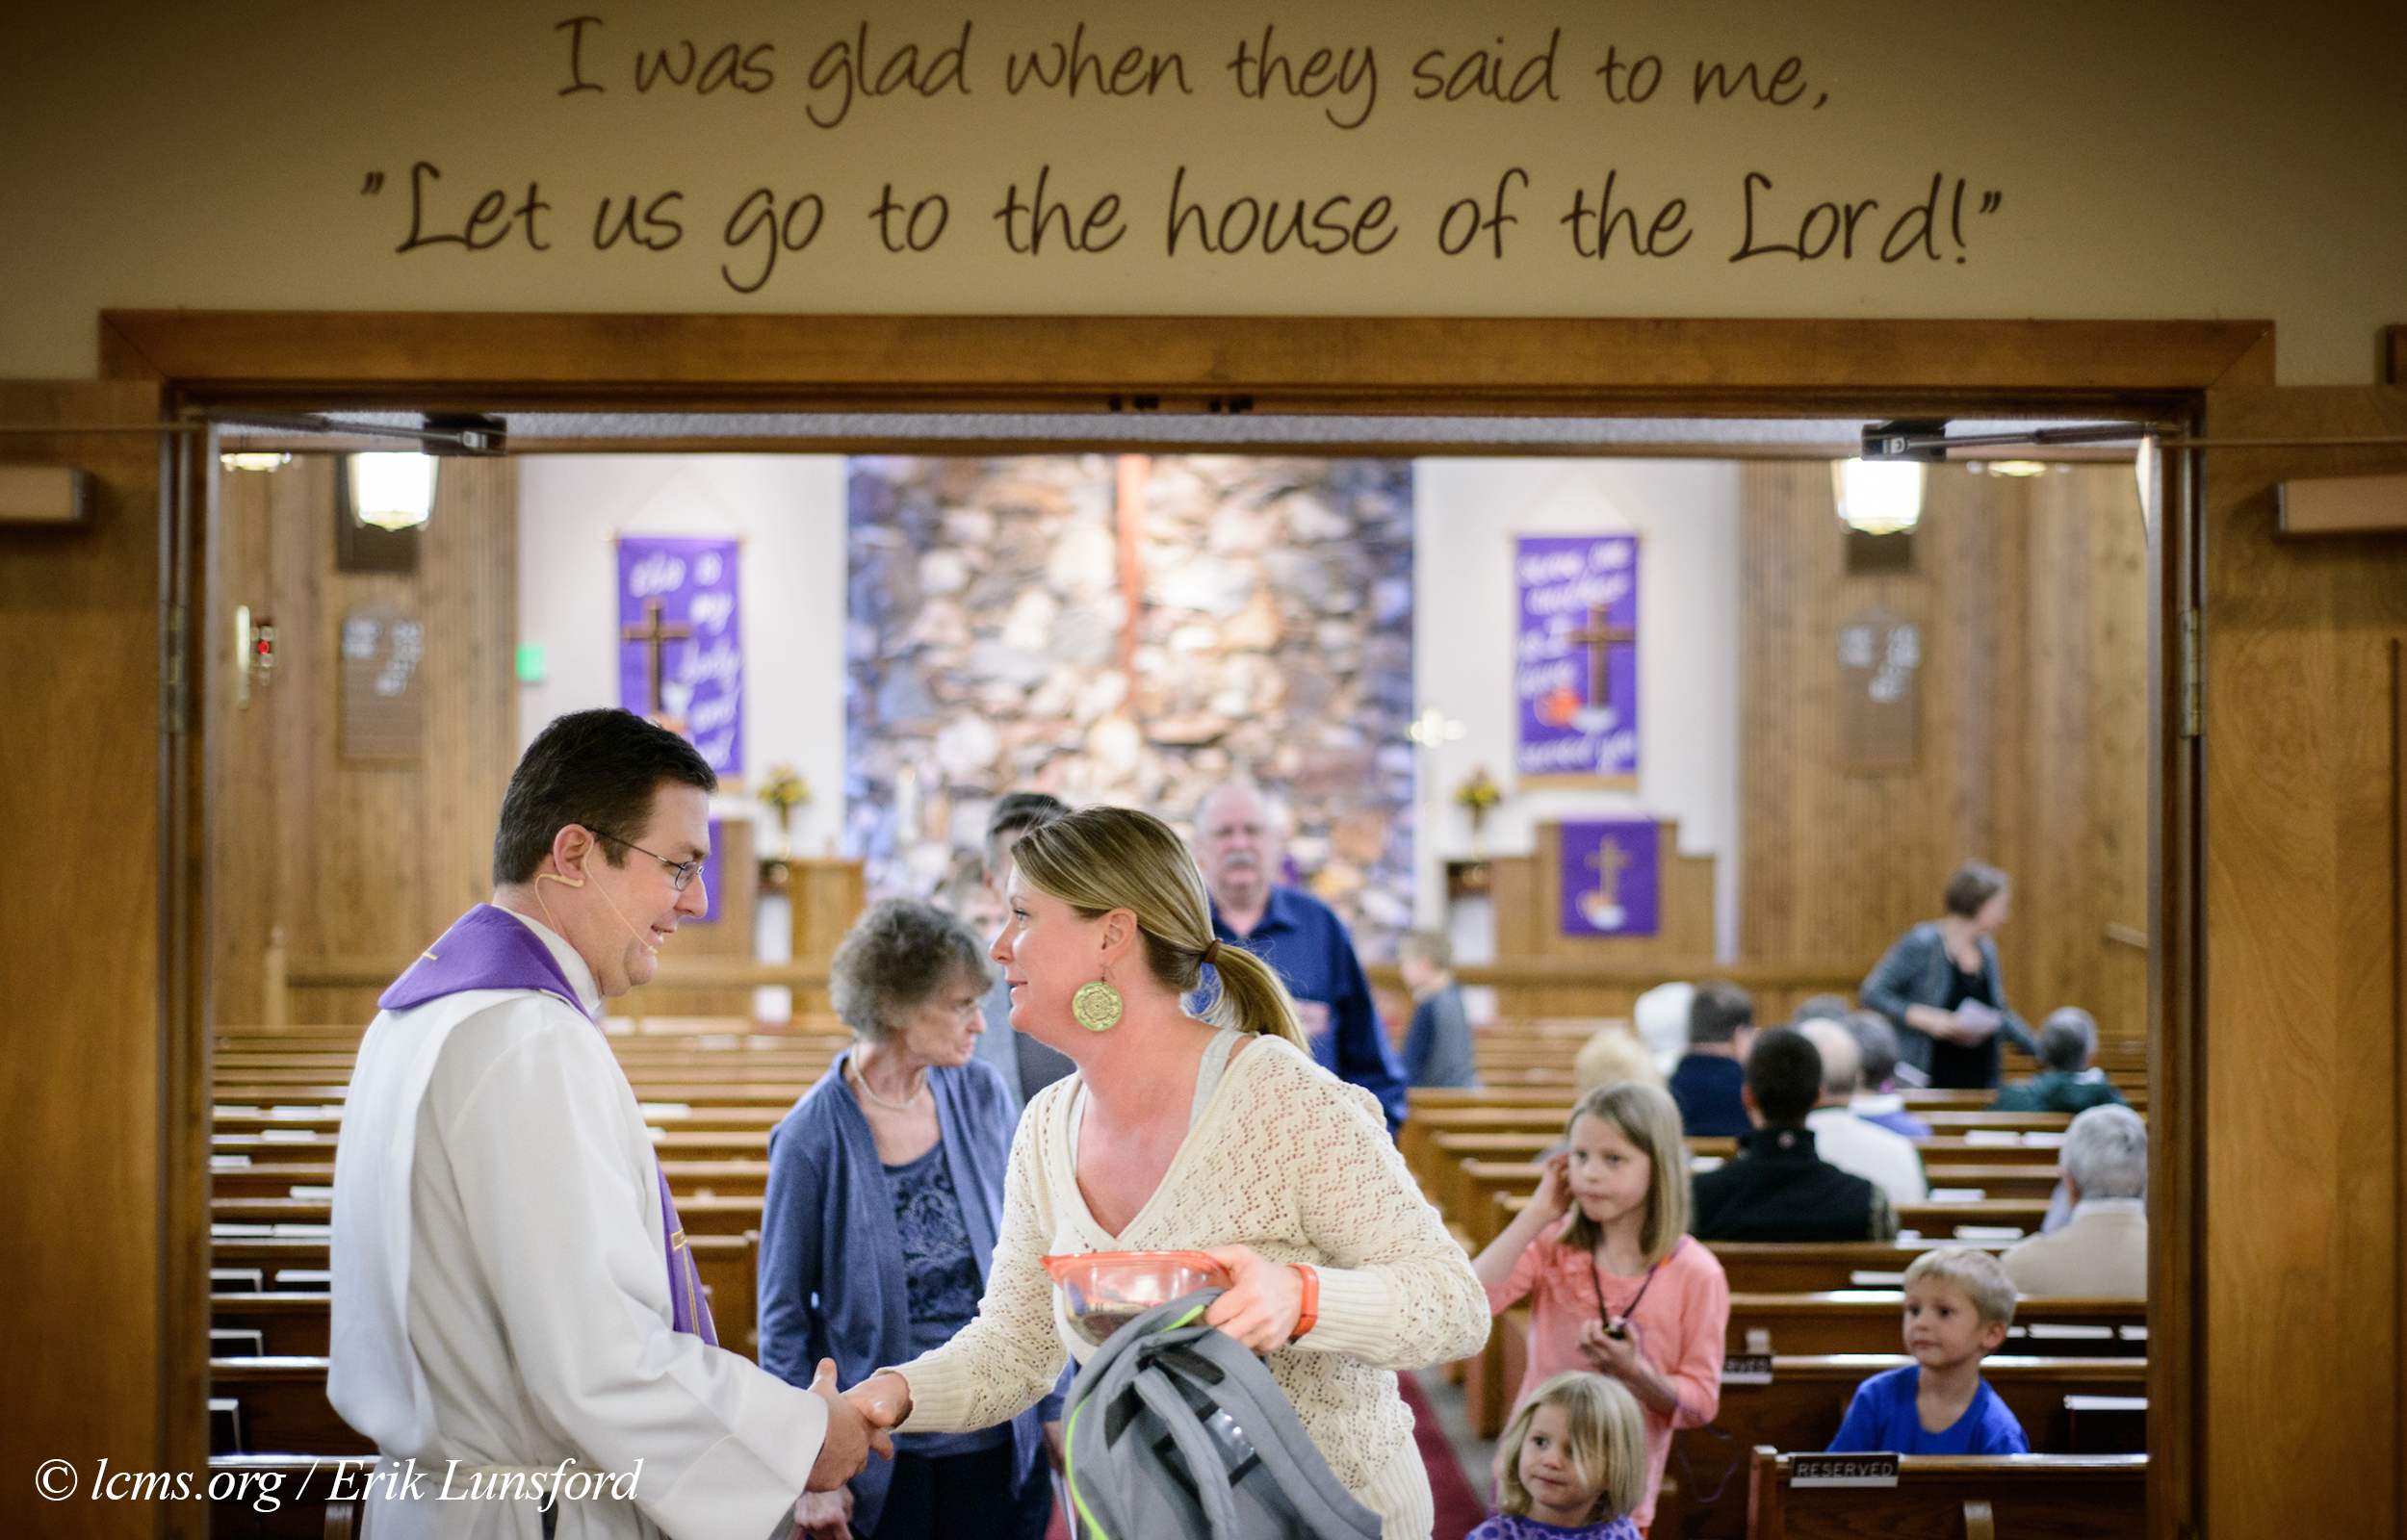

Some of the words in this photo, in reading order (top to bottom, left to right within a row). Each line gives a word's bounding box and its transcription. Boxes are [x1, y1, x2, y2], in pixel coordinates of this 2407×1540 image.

[554, 14, 605, 97] I
[634, 39, 775, 96] was
[805, 19, 973, 130] glad
[1005, 21, 1194, 98] when
[1227, 19, 1378, 131] they
[1411, 26, 1562, 104] said
[1595, 44, 1664, 105] to
[1693, 54, 1829, 111] me,
[592, 190, 685, 253] us
[720, 187, 825, 295] go
[867, 182, 950, 254] to
[992, 164, 1127, 257] the
[1166, 165, 1399, 258] house
[1437, 167, 1530, 260] of
[1560, 168, 1694, 261] the
[1797, 1461, 1894, 1477] RESERVED
